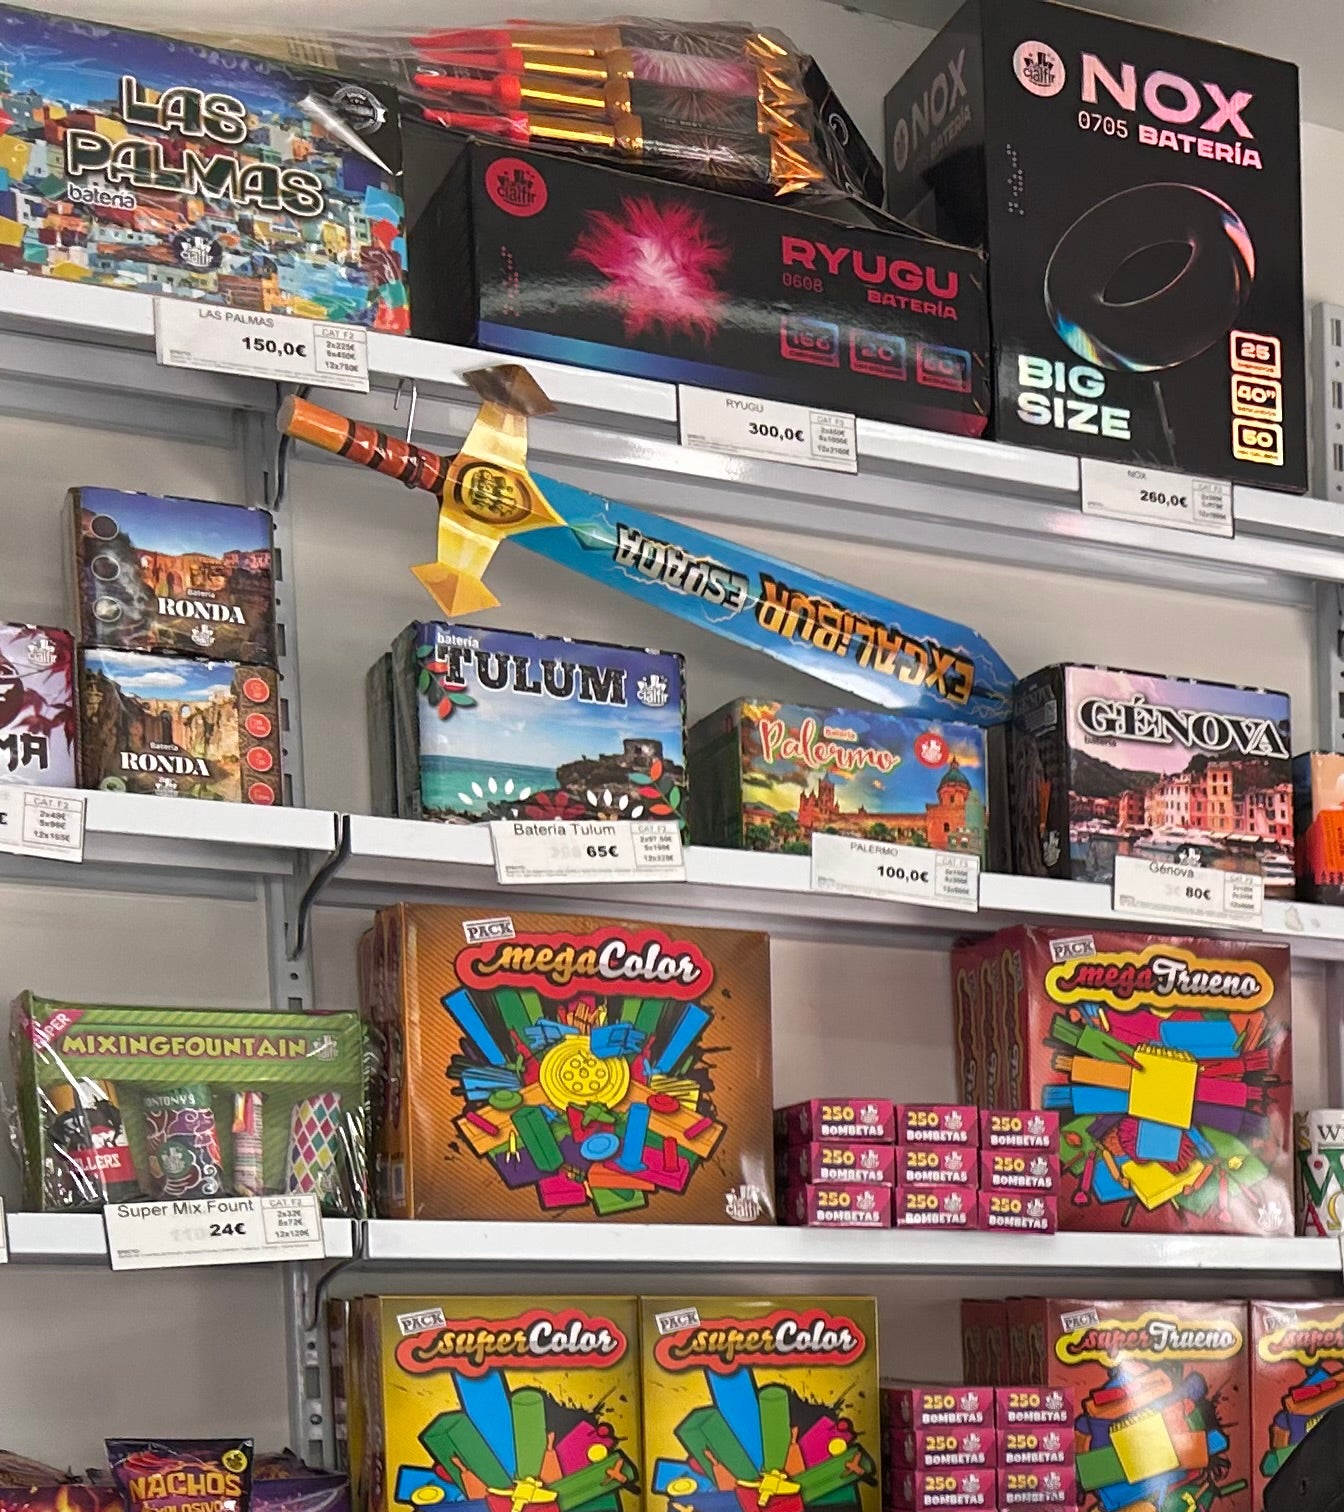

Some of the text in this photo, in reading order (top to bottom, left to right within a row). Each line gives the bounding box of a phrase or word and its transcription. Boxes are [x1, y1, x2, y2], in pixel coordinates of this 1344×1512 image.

[1081, 52, 1256, 139] NOX
[120, 75, 247, 145] LAS
[1078, 109, 1263, 170] 0705 BATERÍA
[66, 128, 325, 217] PALMAS
[781, 235, 959, 300] RYUGU
[867, 289, 958, 321] BATERÍA
[199, 309, 275, 328] LAS PALMAS
[242, 336, 307, 358] 150,0€
[1241, 342, 1270, 361] 25
[1018, 354, 1106, 398] BIG
[726, 399, 764, 413] RYUGU
[1018, 391, 1132, 440] SIZE
[749, 422, 805, 442] 300,0€
[158, 597, 246, 625] RONDA
[437, 644, 628, 706] TULUM
[1078, 692, 1290, 760] GÉNOVA
[760, 717, 901, 772] Palermo
[120, 751, 210, 777] RONDA
[570, 823, 616, 837] Tulum
[586, 844, 619, 858] 65€
[849, 841, 899, 857] PALERMO
[877, 864, 929, 883] 100,0€
[1149, 861, 1195, 879] Génova
[1186, 886, 1211, 900] 80€
[467, 922, 513, 940] PACK
[1053, 941, 1095, 958] PACK
[478, 940, 701, 984] megaColor
[1060, 957, 1262, 997] megaTrueno
[62, 1034, 307, 1059] MIXINGFOUNTAIN
[822, 1106, 854, 1122] 250
[907, 1111, 939, 1127] 250
[821, 1124, 884, 1137] BOMBETAS
[991, 1116, 1022, 1132] 250
[906, 1129, 967, 1142] BOMBETAS
[990, 1134, 1050, 1147] BOMBETAS
[822, 1149, 854, 1166] 250
[907, 1152, 939, 1167] 250
[994, 1156, 1025, 1172] 250
[820, 1168, 884, 1181] BOMBETAS
[906, 1170, 967, 1182] BOMBETAS
[992, 1175, 1052, 1188] BOMBETAS
[818, 1191, 850, 1208] 250
[906, 1194, 938, 1209] 250
[991, 1197, 1022, 1213] 250
[118, 1199, 254, 1221] Super Mix Fount
[816, 1210, 880, 1222] BOMBETAS
[905, 1212, 967, 1225] BOMBETAS
[210, 1223, 246, 1238] 24€
[989, 1215, 1048, 1229] BOMBETAS
[402, 1313, 445, 1330] PACK
[659, 1311, 698, 1330] PACK
[419, 1321, 618, 1362] superColor
[677, 1321, 858, 1362] superColor
[1066, 1321, 1237, 1357] superTrueno
[923, 1394, 955, 1410] 250
[1008, 1392, 1041, 1409] 250
[922, 1411, 984, 1424] BOMBETAS
[1008, 1408, 1068, 1424] BOMBETAS
[926, 1435, 958, 1451] 250
[1006, 1434, 1038, 1450] 250
[924, 1451, 986, 1466] BOMBETAS
[1006, 1450, 1065, 1465] BOMBETAS
[129, 1472, 244, 1499] NACHOS
[925, 1475, 957, 1492] 250
[1007, 1474, 1038, 1490] 250
[924, 1492, 985, 1507] BOMBETAS
[1006, 1490, 1066, 1504] BOMBETAS
